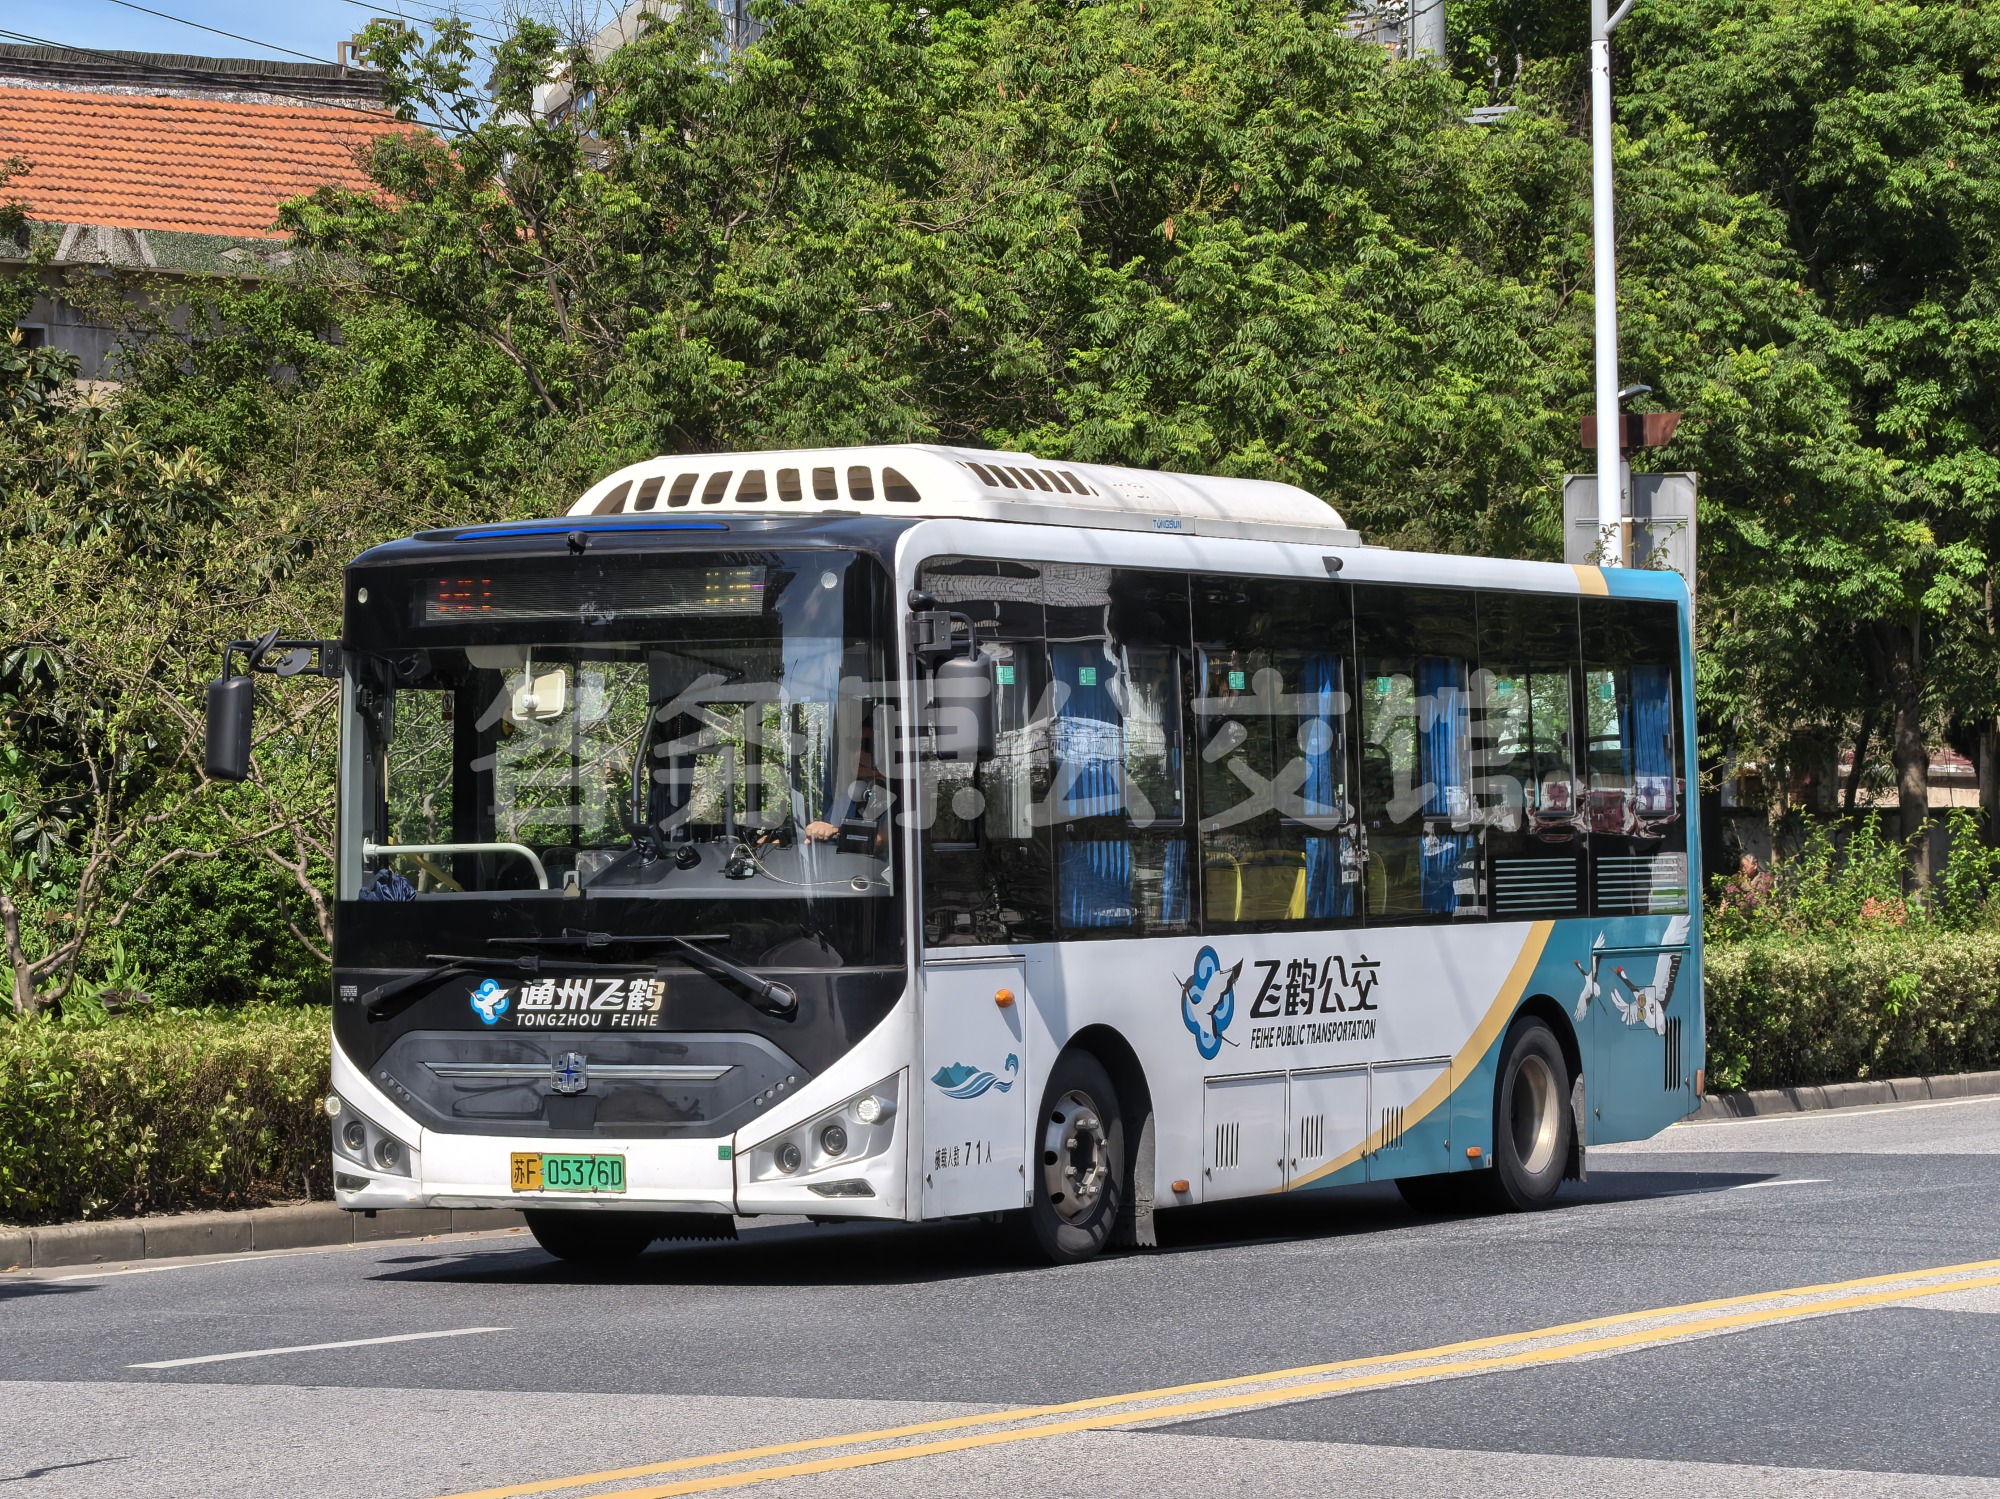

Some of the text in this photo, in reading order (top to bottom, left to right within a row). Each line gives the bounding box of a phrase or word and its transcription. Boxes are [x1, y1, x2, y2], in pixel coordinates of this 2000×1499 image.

[517, 978, 665, 1011] 通州飞鹤
[1250, 954, 1381, 1018] 飞鹤公交
[516, 1013, 659, 1027] TONGZHOU FEIHE
[1250, 1019, 1377, 1049] FEIHE PUBLIC TRANSPORTATION
